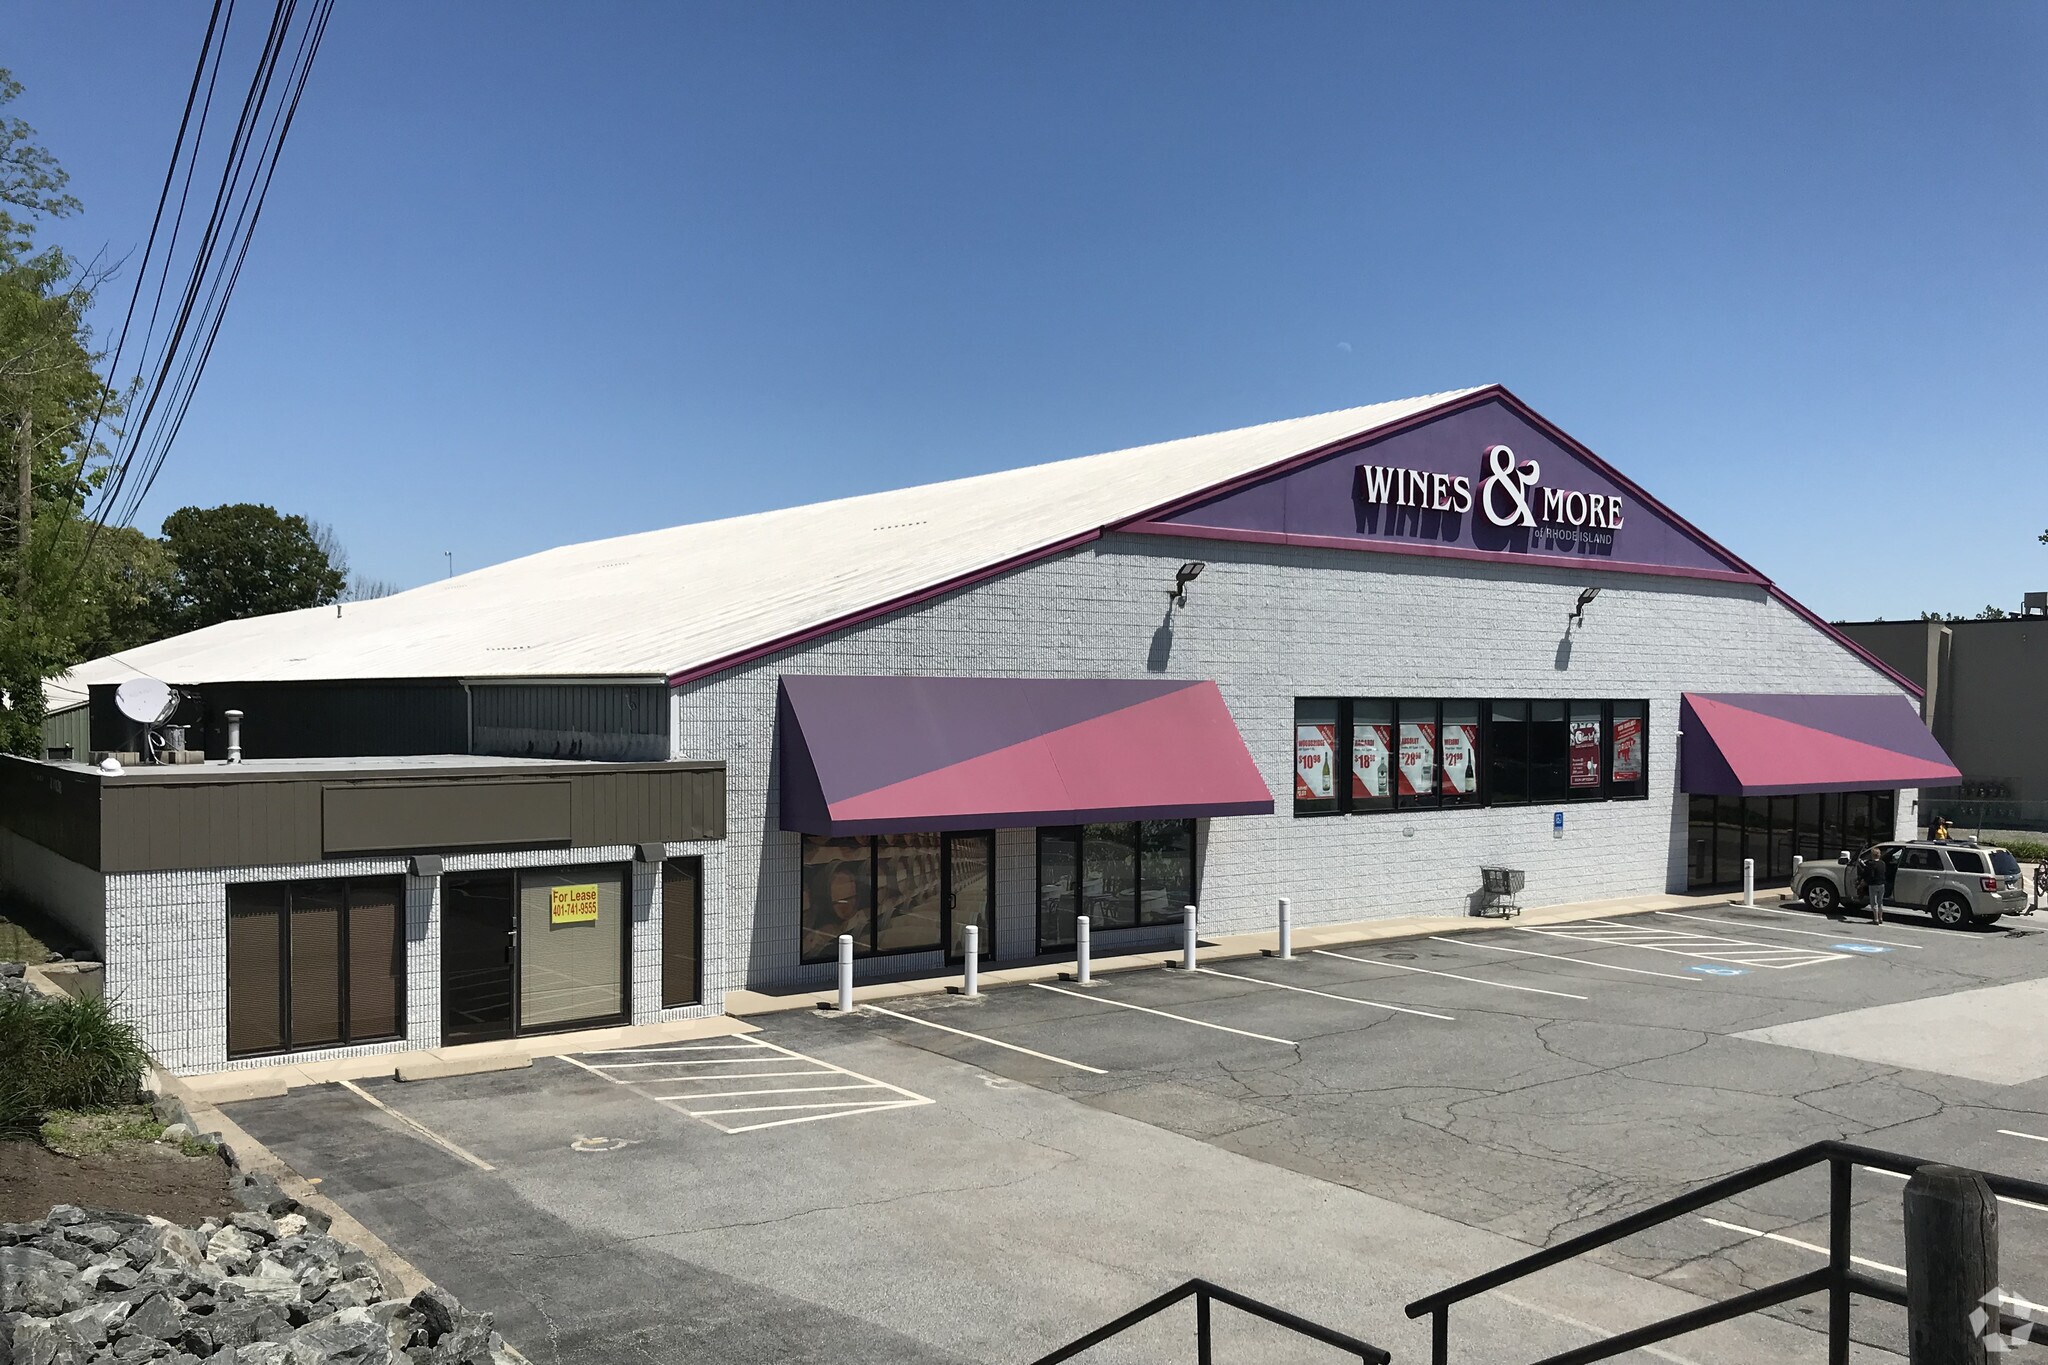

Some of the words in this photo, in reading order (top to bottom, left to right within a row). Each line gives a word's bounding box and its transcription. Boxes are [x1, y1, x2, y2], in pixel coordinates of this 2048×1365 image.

[1363, 464, 1473, 513] WINES
[1482, 444, 1540, 528] &
[1542, 486, 1624, 530] MORE
[1535, 528, 1544, 539] of
[1546, 528, 1577, 541] RHODE
[1580, 531, 1612, 545] ISLAND
[553, 890, 568, 903] For
[571, 889, 596, 902] Lease
[553, 901, 597, 917] 401-741-9555
